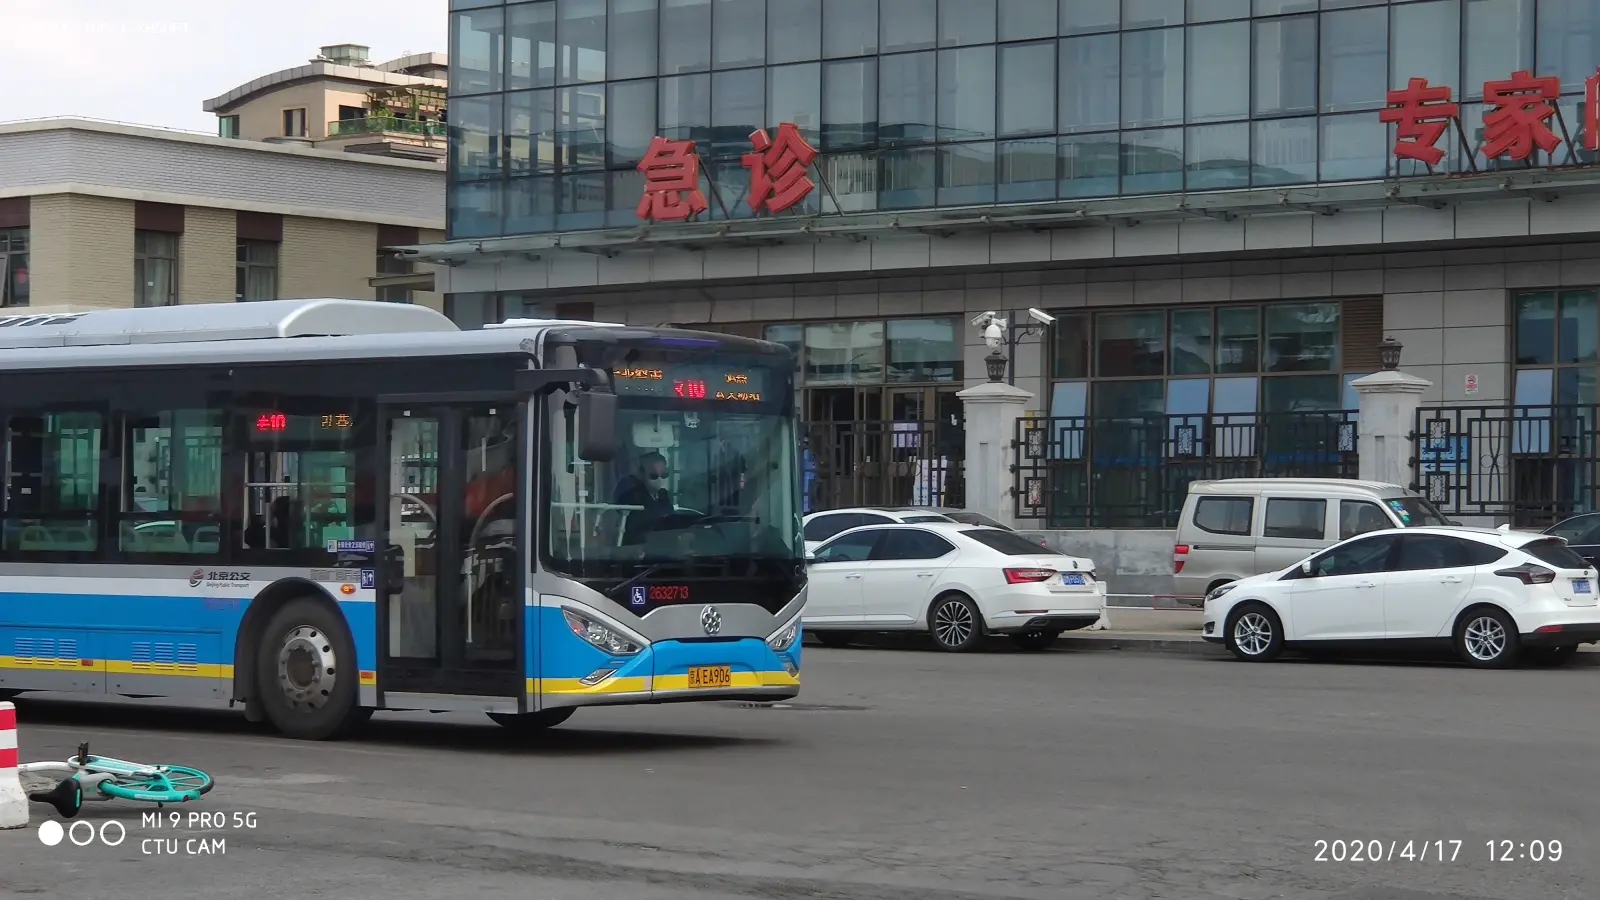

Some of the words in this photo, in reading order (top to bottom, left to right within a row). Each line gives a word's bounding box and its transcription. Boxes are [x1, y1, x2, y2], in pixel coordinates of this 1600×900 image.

[637, 122, 817, 221] 急诊
[207, 571, 251, 581] 北京公交
[649, 585, 689, 600] 2632713
